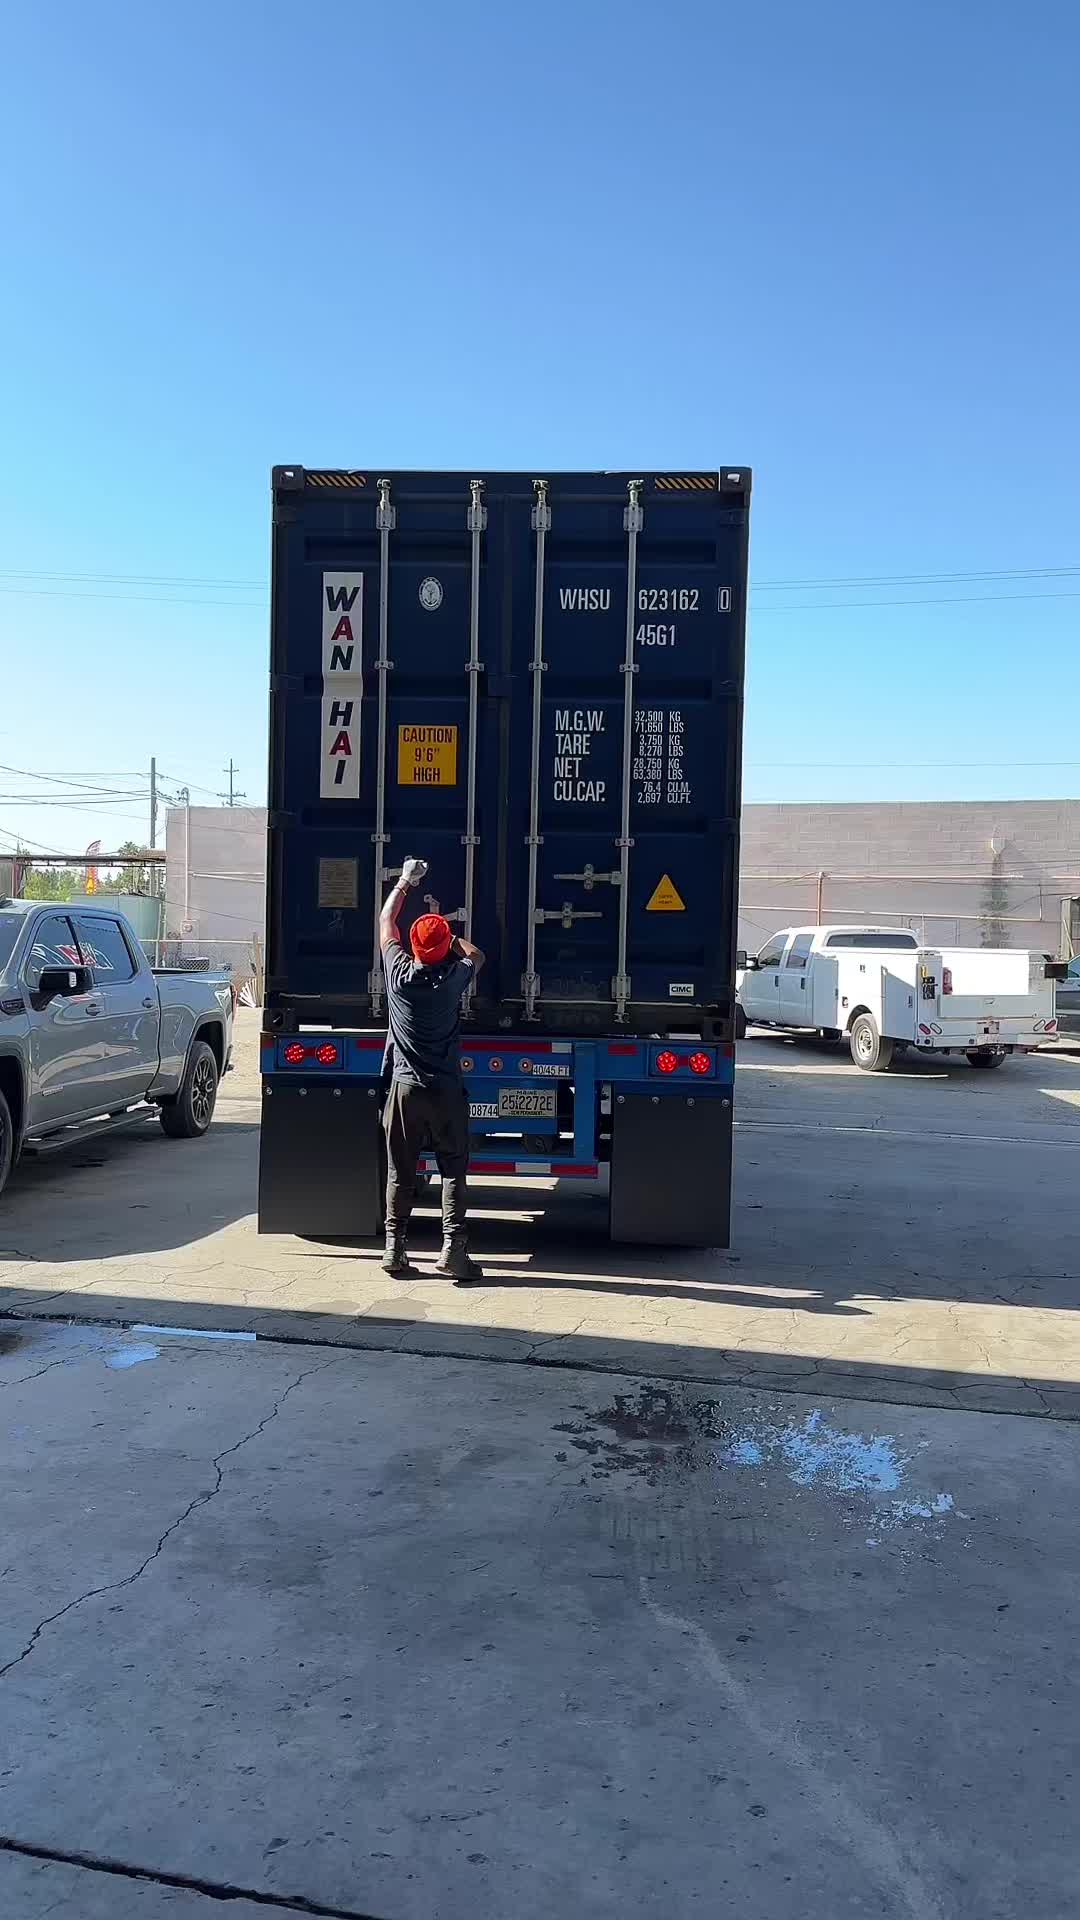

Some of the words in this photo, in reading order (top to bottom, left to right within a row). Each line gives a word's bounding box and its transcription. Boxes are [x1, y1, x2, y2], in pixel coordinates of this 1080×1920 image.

[560, 588, 611, 610] WHSU
[638, 589, 699, 611] 623162
[719, 588, 730, 611] 0
[326, 586, 360, 671] WAN
[636, 624, 676, 646] 45G1
[555, 710, 605, 731] M.G.W.
[669, 711, 681, 722] KG
[669, 722, 684, 733] LBS
[329, 701, 354, 784] HAI
[403, 727, 453, 743] CAUTION
[555, 734, 591, 755] TARE
[668, 735, 681, 746] KG
[668, 746, 684, 757] LBS
[413, 767, 441, 782] HIGH
[554, 757, 582, 778] NET
[668, 758, 680, 770] KG
[667, 769, 683, 780] LBS
[553, 780, 606, 802] CU.CAP.
[558, 1065, 569, 1074] FT
[469, 1104, 498, 1116] 08744
